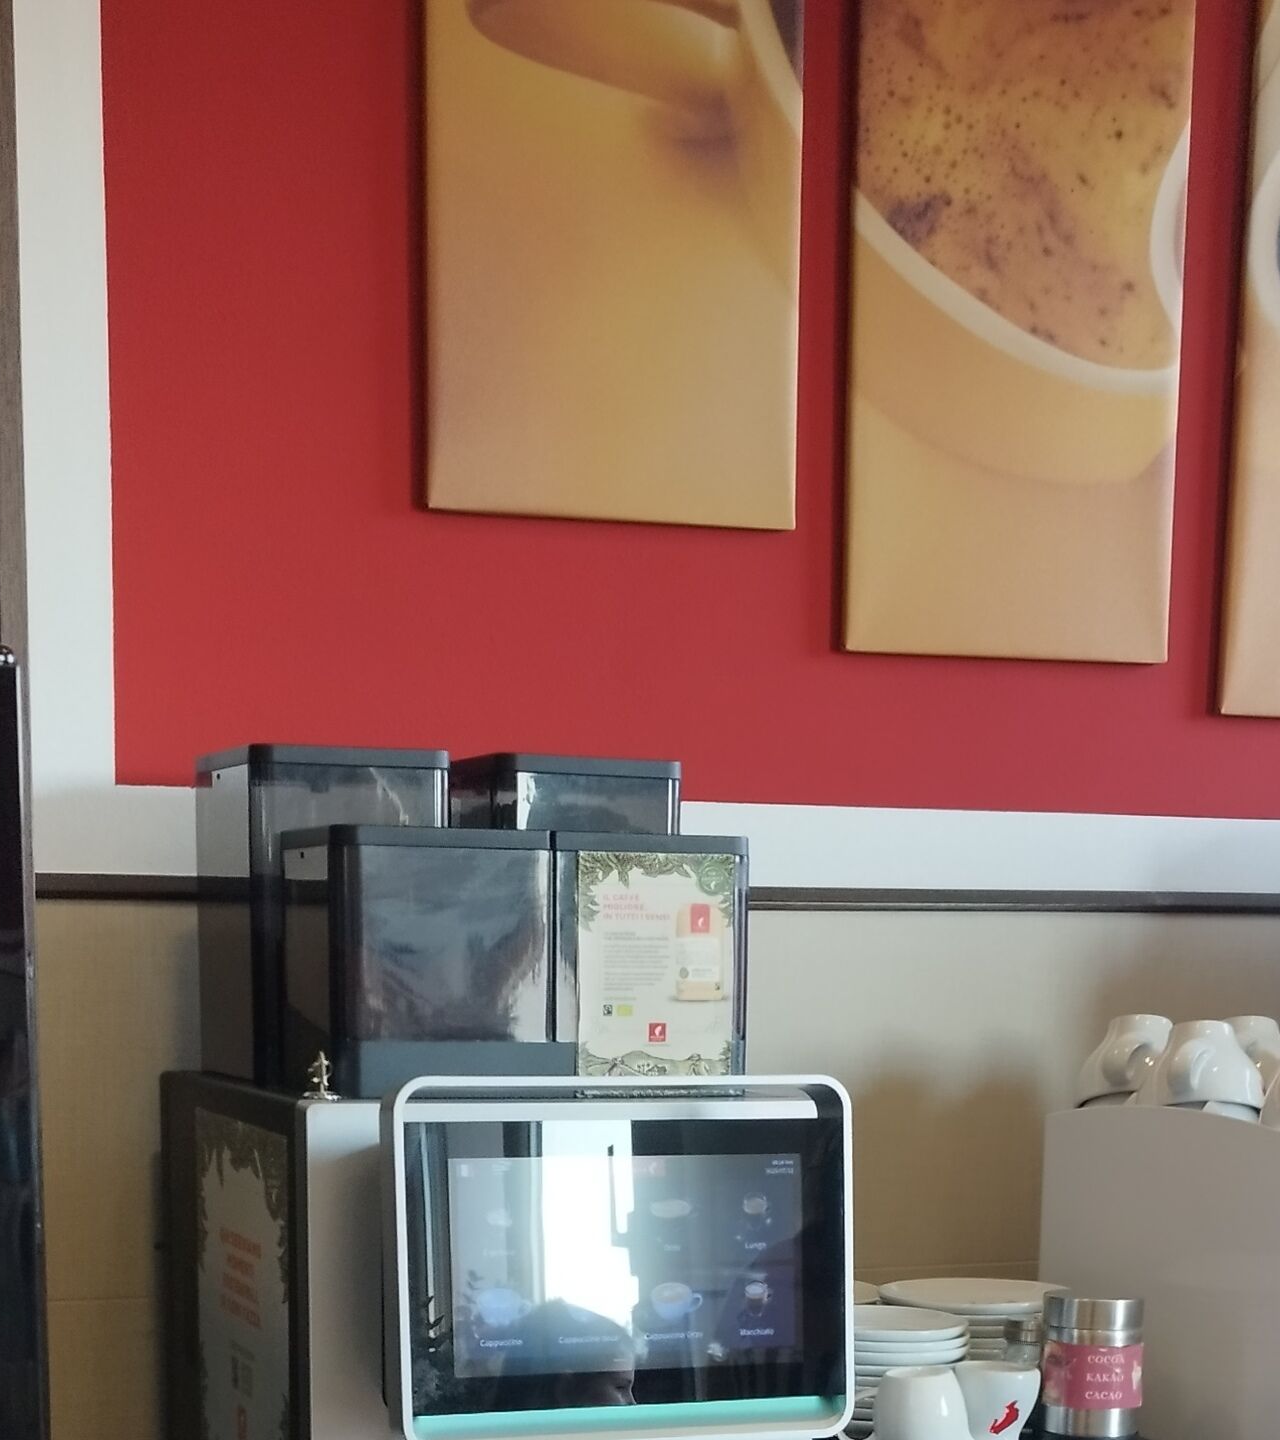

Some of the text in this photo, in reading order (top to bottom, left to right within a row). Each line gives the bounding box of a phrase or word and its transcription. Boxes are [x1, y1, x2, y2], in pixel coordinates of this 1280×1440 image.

[1087, 1354, 1125, 1365] COCOA
[1086, 1372, 1124, 1382] KAKAO
[1085, 1390, 1123, 1400] CACAO
